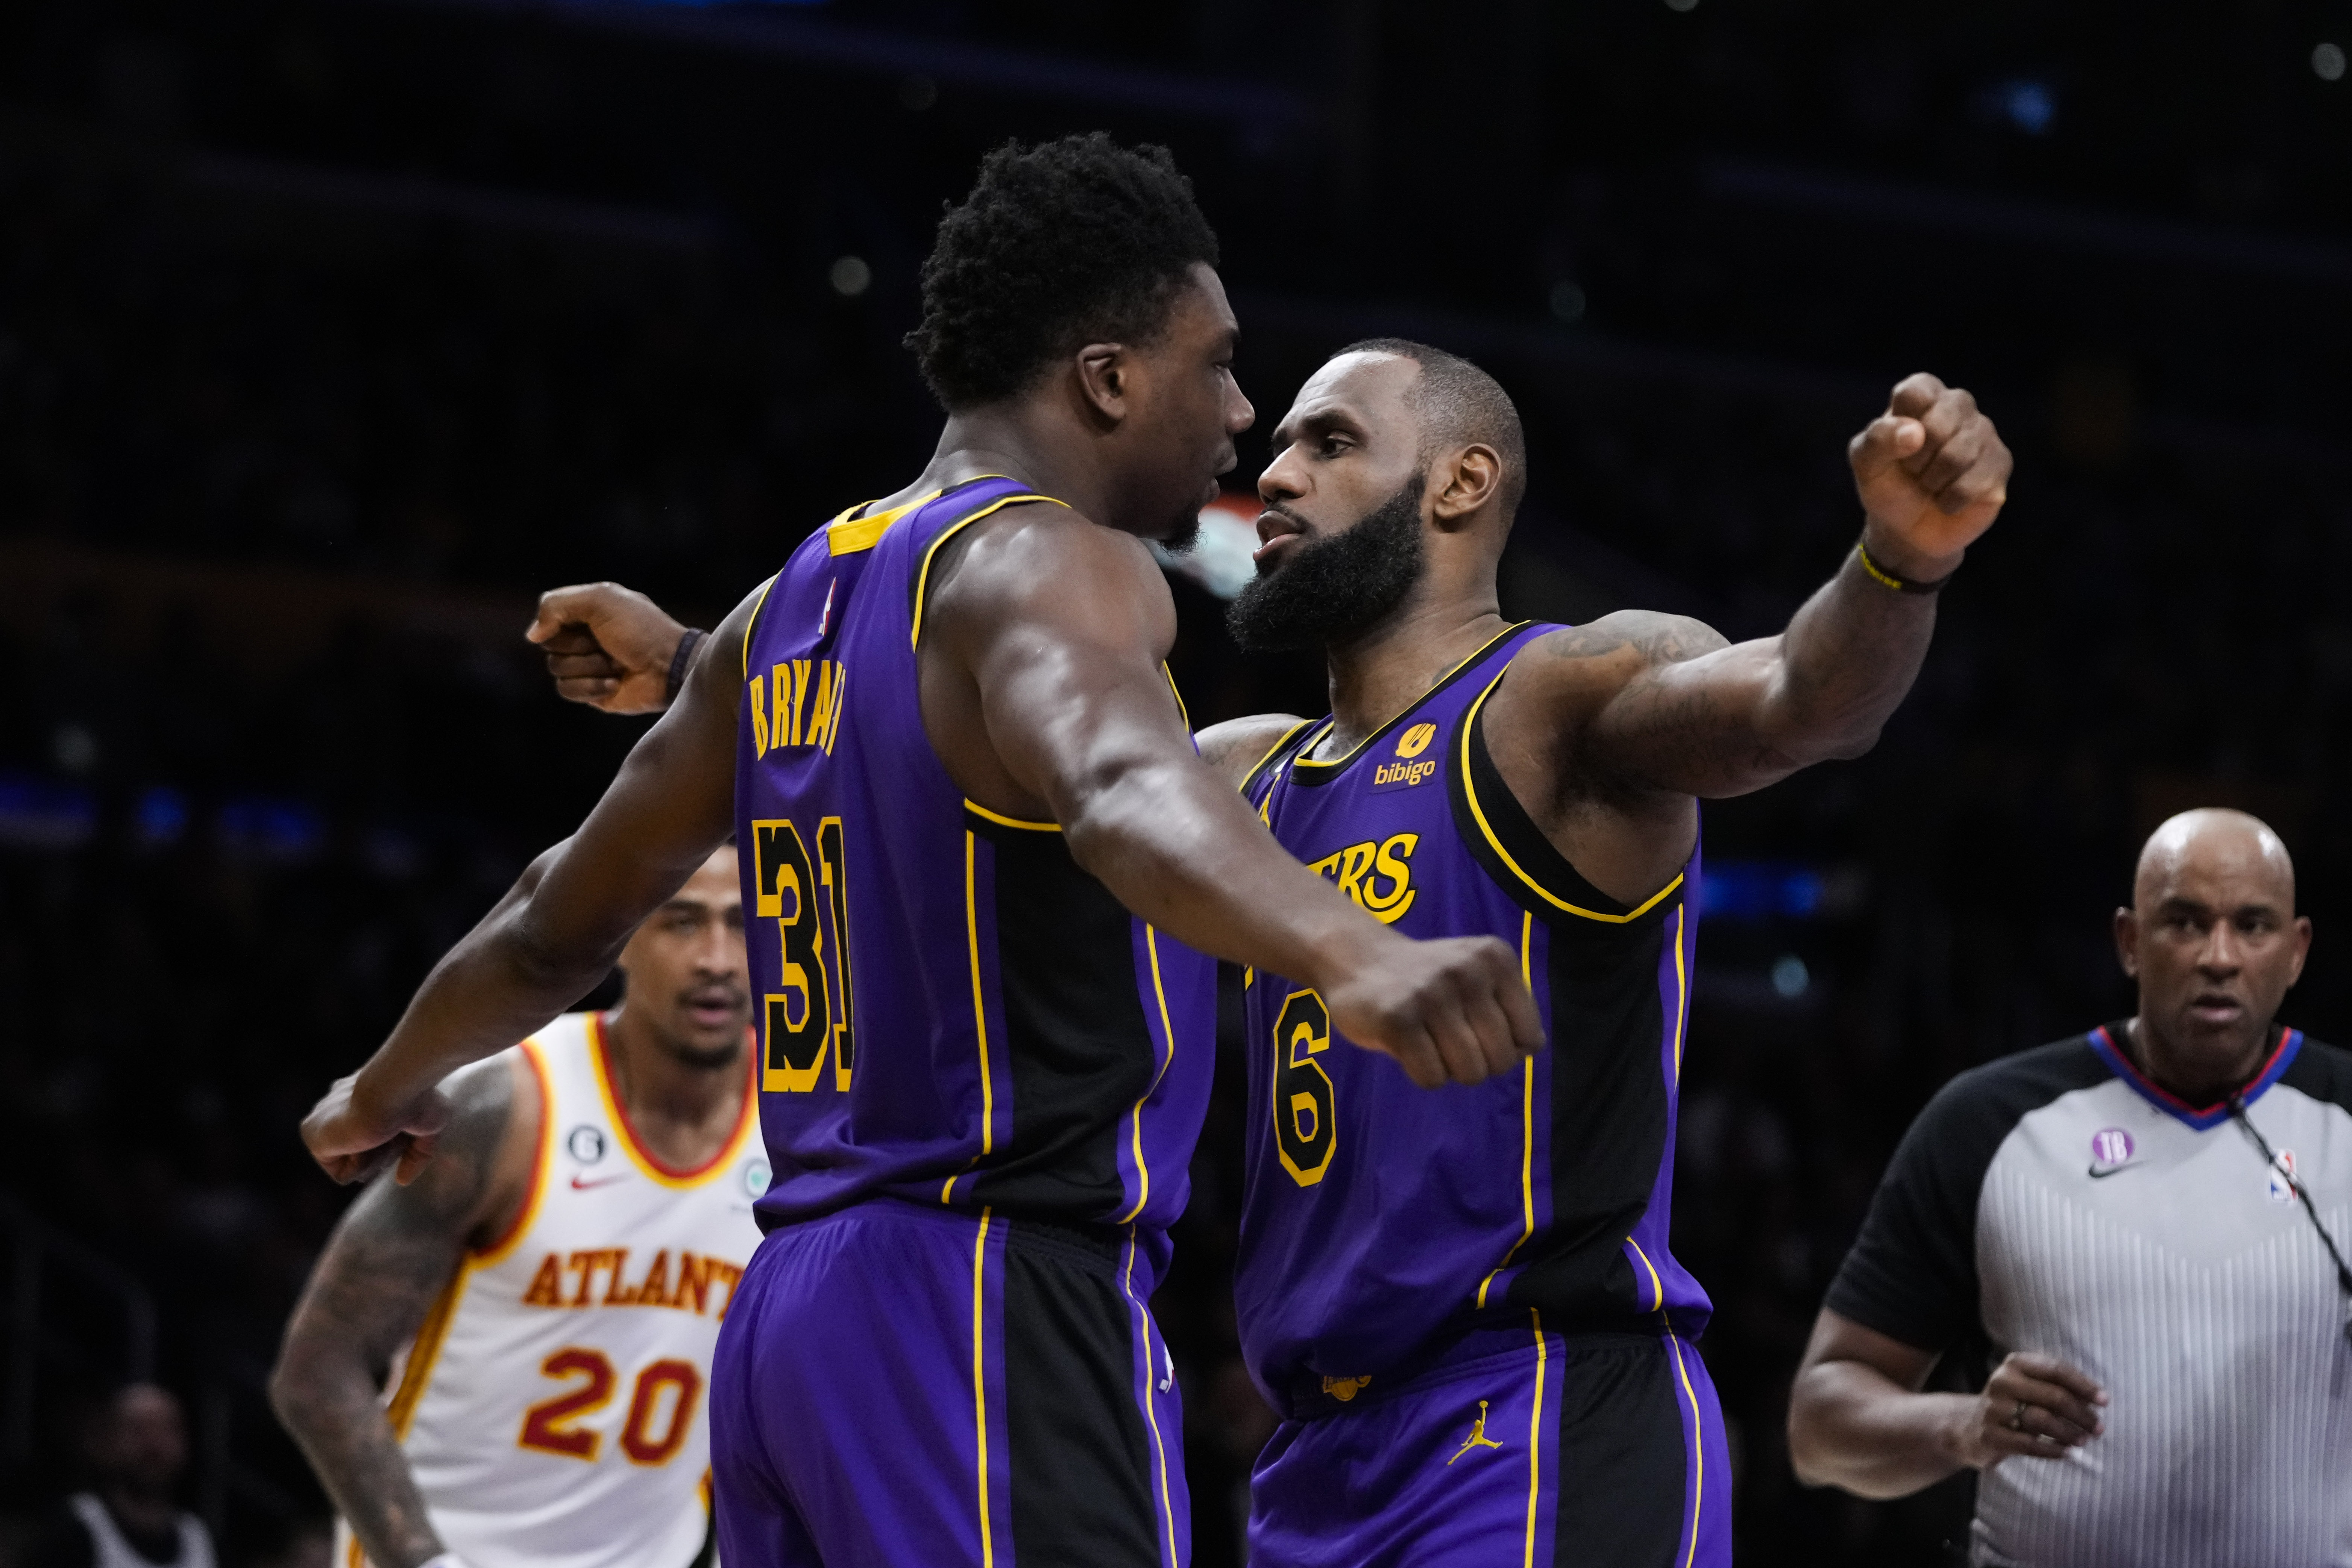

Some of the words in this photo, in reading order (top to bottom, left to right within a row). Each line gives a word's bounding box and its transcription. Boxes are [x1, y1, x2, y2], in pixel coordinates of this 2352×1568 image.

[1374, 760, 1435, 786] bibigo
[752, 816, 854, 1092] 31
[1273, 987, 1337, 1187] 6
[517, 1346, 703, 1468] 20
